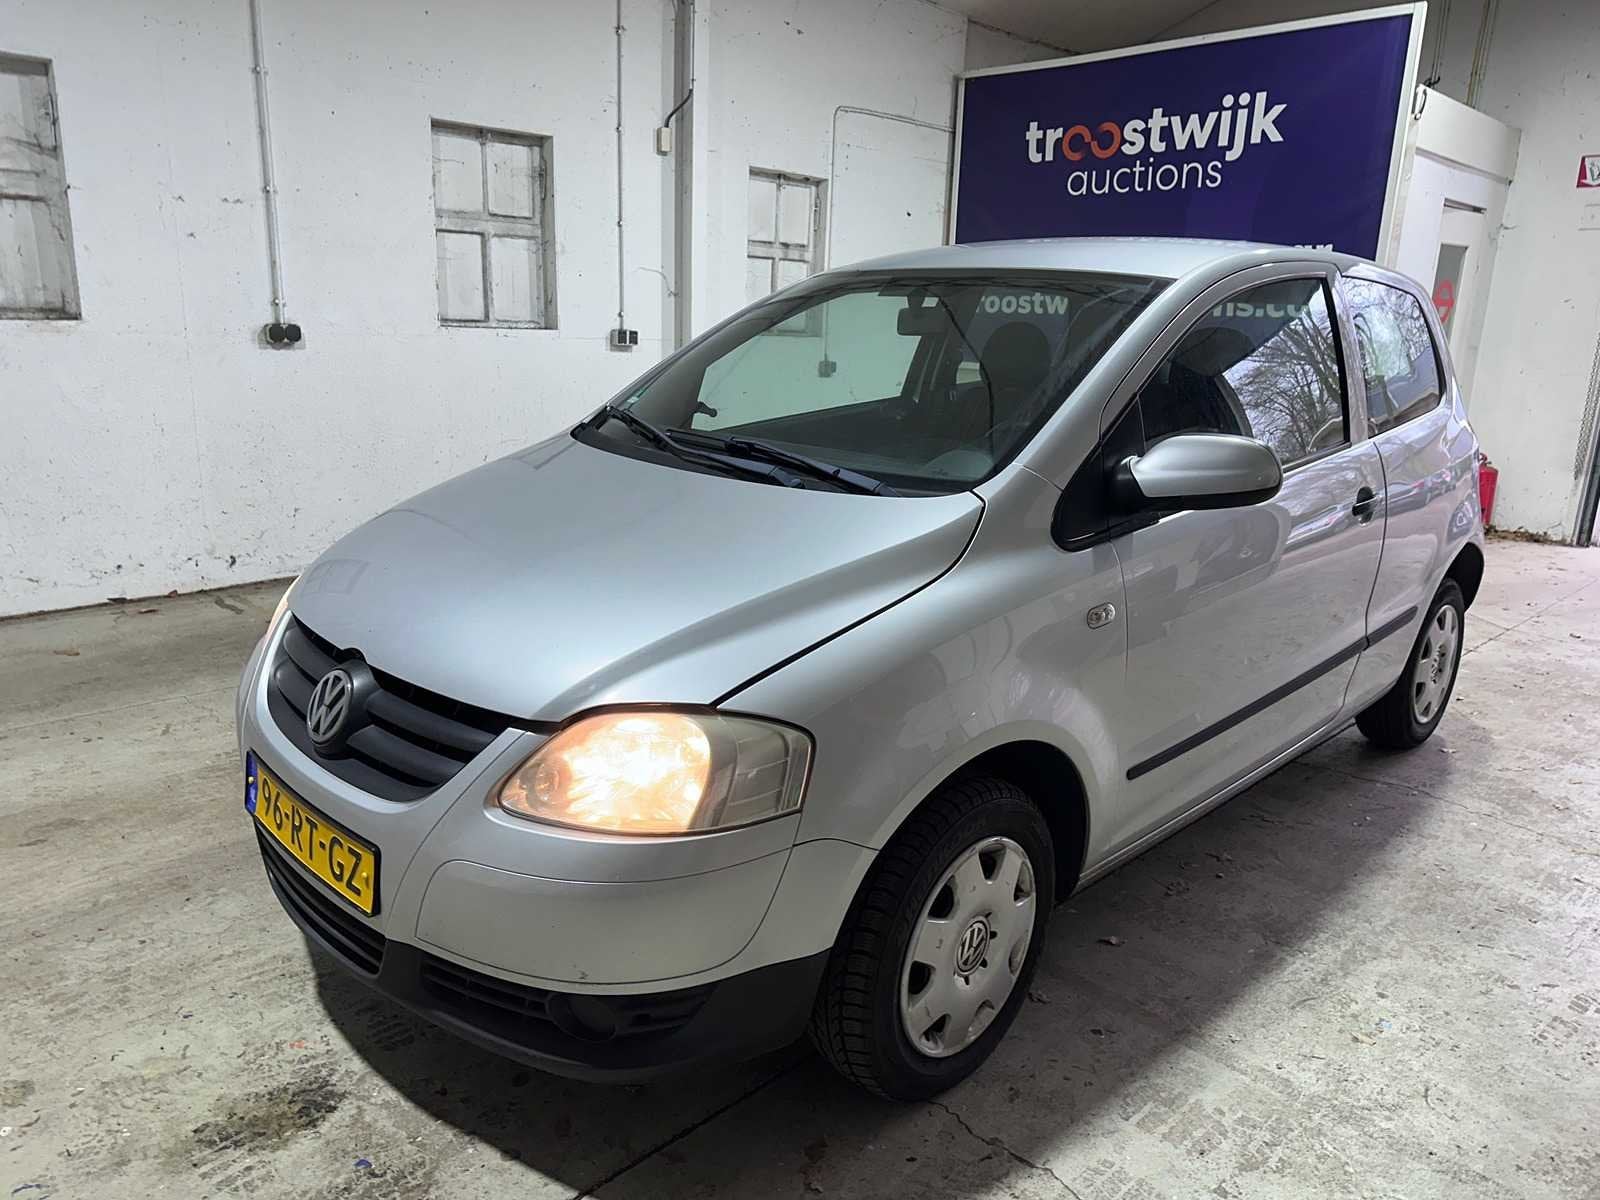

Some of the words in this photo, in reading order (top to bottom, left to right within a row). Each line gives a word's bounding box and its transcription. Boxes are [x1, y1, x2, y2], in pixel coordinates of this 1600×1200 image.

[1026, 91, 1287, 163] troostwijk
[1066, 157, 1223, 196] auctions
[261, 776, 363, 897] 96-RT-GZ
